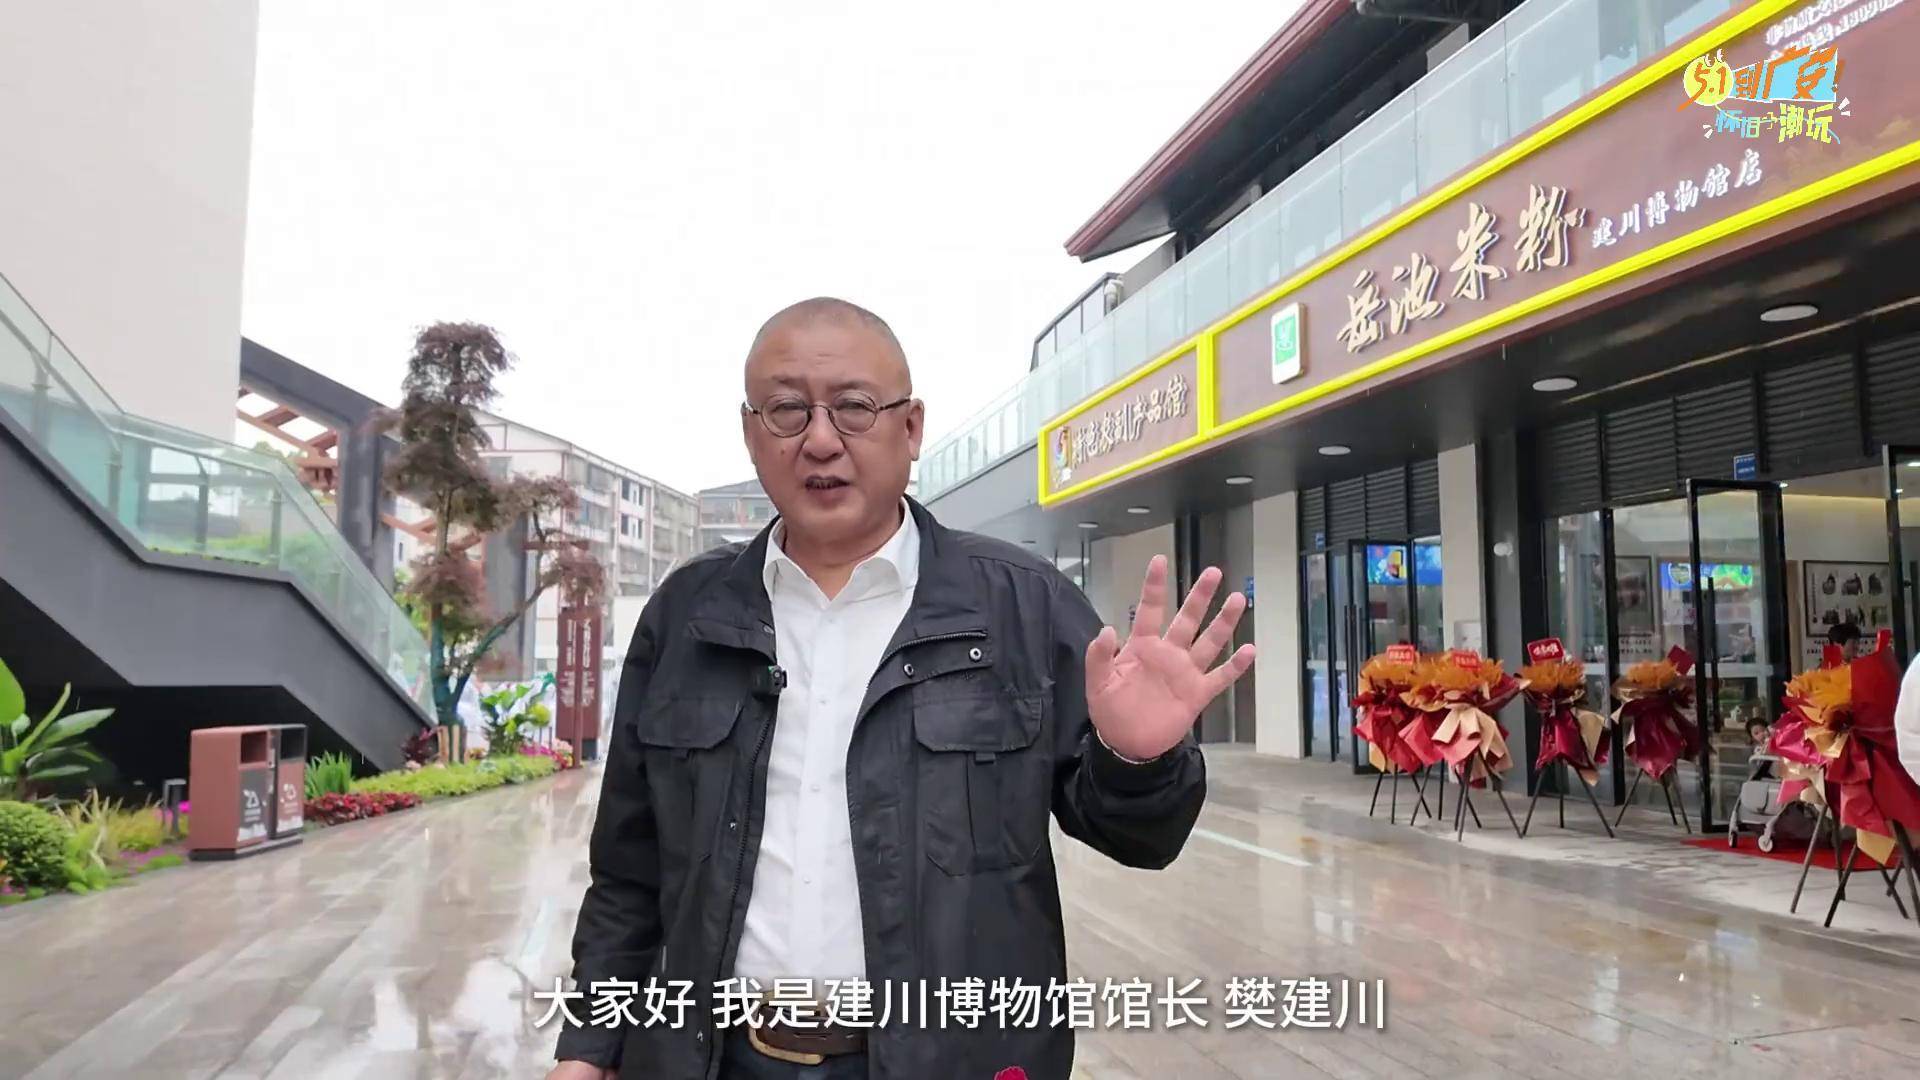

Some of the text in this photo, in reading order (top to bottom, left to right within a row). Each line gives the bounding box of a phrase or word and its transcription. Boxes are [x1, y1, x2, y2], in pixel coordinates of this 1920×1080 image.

[1592, 149, 1764, 249] 建川博物馆店
[1336, 184, 1587, 354] 岳池米粉
